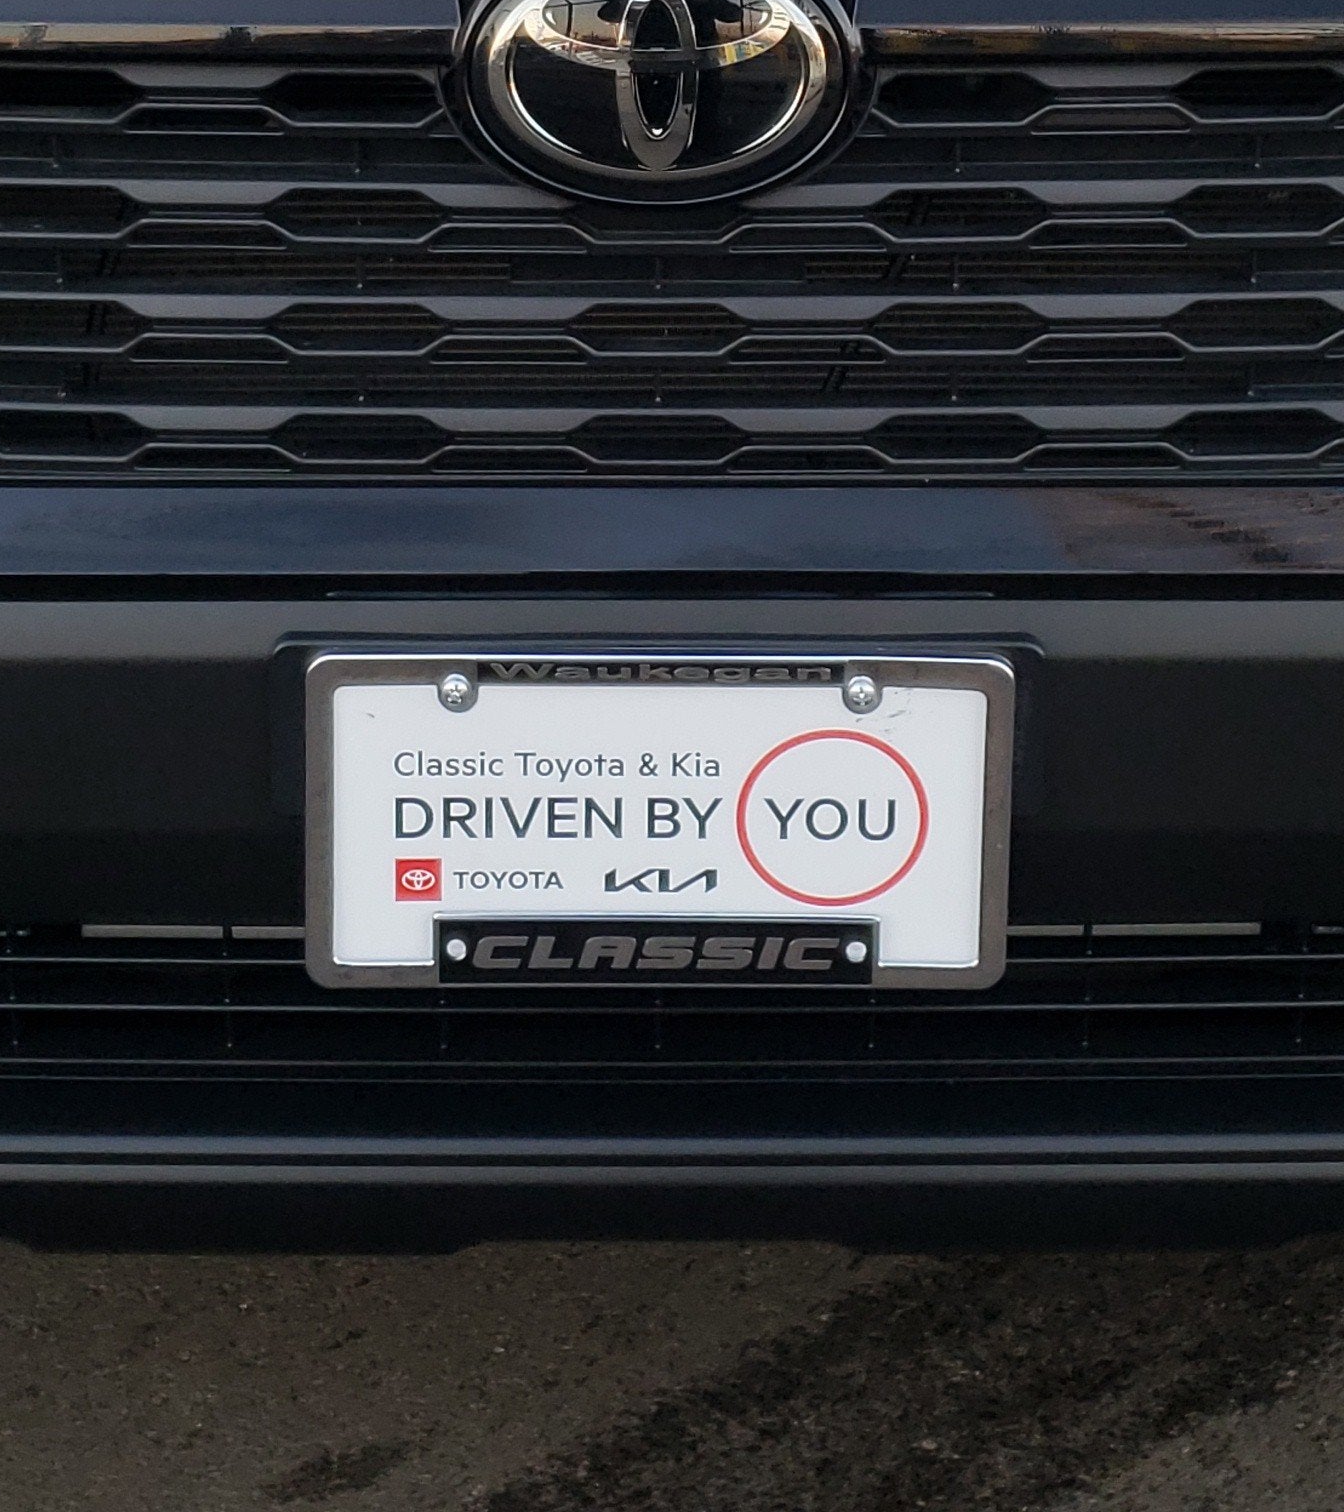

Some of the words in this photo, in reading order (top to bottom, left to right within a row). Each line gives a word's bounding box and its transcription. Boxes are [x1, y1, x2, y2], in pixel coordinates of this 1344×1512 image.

[489, 662, 832, 683] Waukegan
[393, 750, 504, 778] Classic
[513, 751, 625, 784] Toyota
[637, 751, 659, 778] &
[670, 751, 721, 778] Kia
[394, 796, 623, 840] DRIVEN
[646, 796, 723, 840] BY
[763, 796, 897, 841] YOU
[452, 870, 564, 891] TOYOTA
[471, 935, 843, 970] CLASSIC
